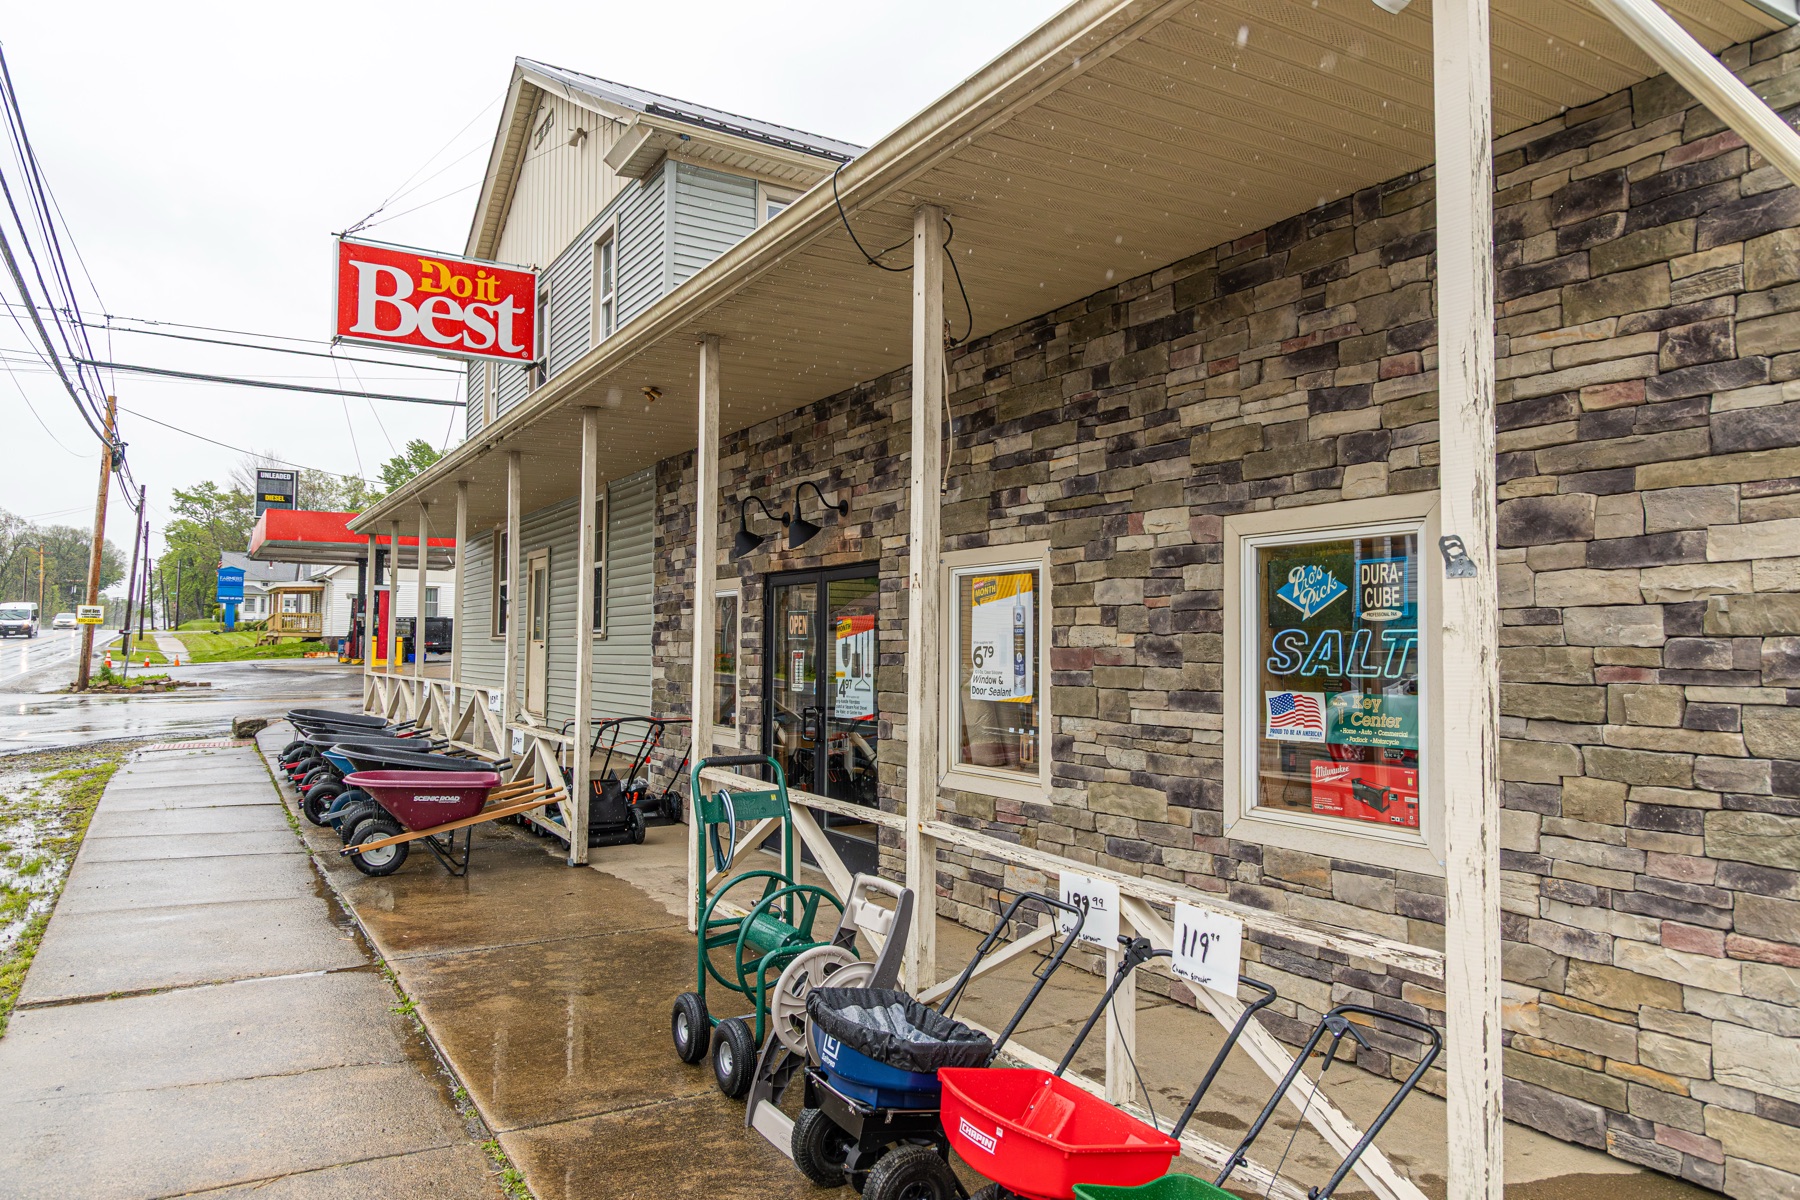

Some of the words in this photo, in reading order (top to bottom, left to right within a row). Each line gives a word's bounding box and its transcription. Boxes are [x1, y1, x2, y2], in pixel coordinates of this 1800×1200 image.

[417, 259, 473, 297] Do
[474, 270, 501, 303] it
[348, 259, 526, 353] Best
[260, 472, 291, 480] UNLEADED
[264, 494, 285, 502] DIESEL
[1288, 565, 1323, 598] Pro's
[1361, 562, 1403, 585] DURA-
[975, 585, 996, 597] MONTH
[1300, 570, 1338, 622] Pick
[1364, 586, 1401, 608] CUBE
[789, 615, 807, 635] OPEN
[1266, 628, 1419, 679] SALT
[973, 675, 997, 685] Window
[998, 675, 1003, 685] &
[972, 685, 987, 695] Door
[988, 687, 1012, 697] Sealant
[1352, 694, 1382, 713] Key
[1351, 712, 1403, 728] Center
[1372, 738, 1400, 746] Motorcycle
[1314, 765, 1349, 778] Milwaukee
[961, 1122, 994, 1149] CHAPIN
